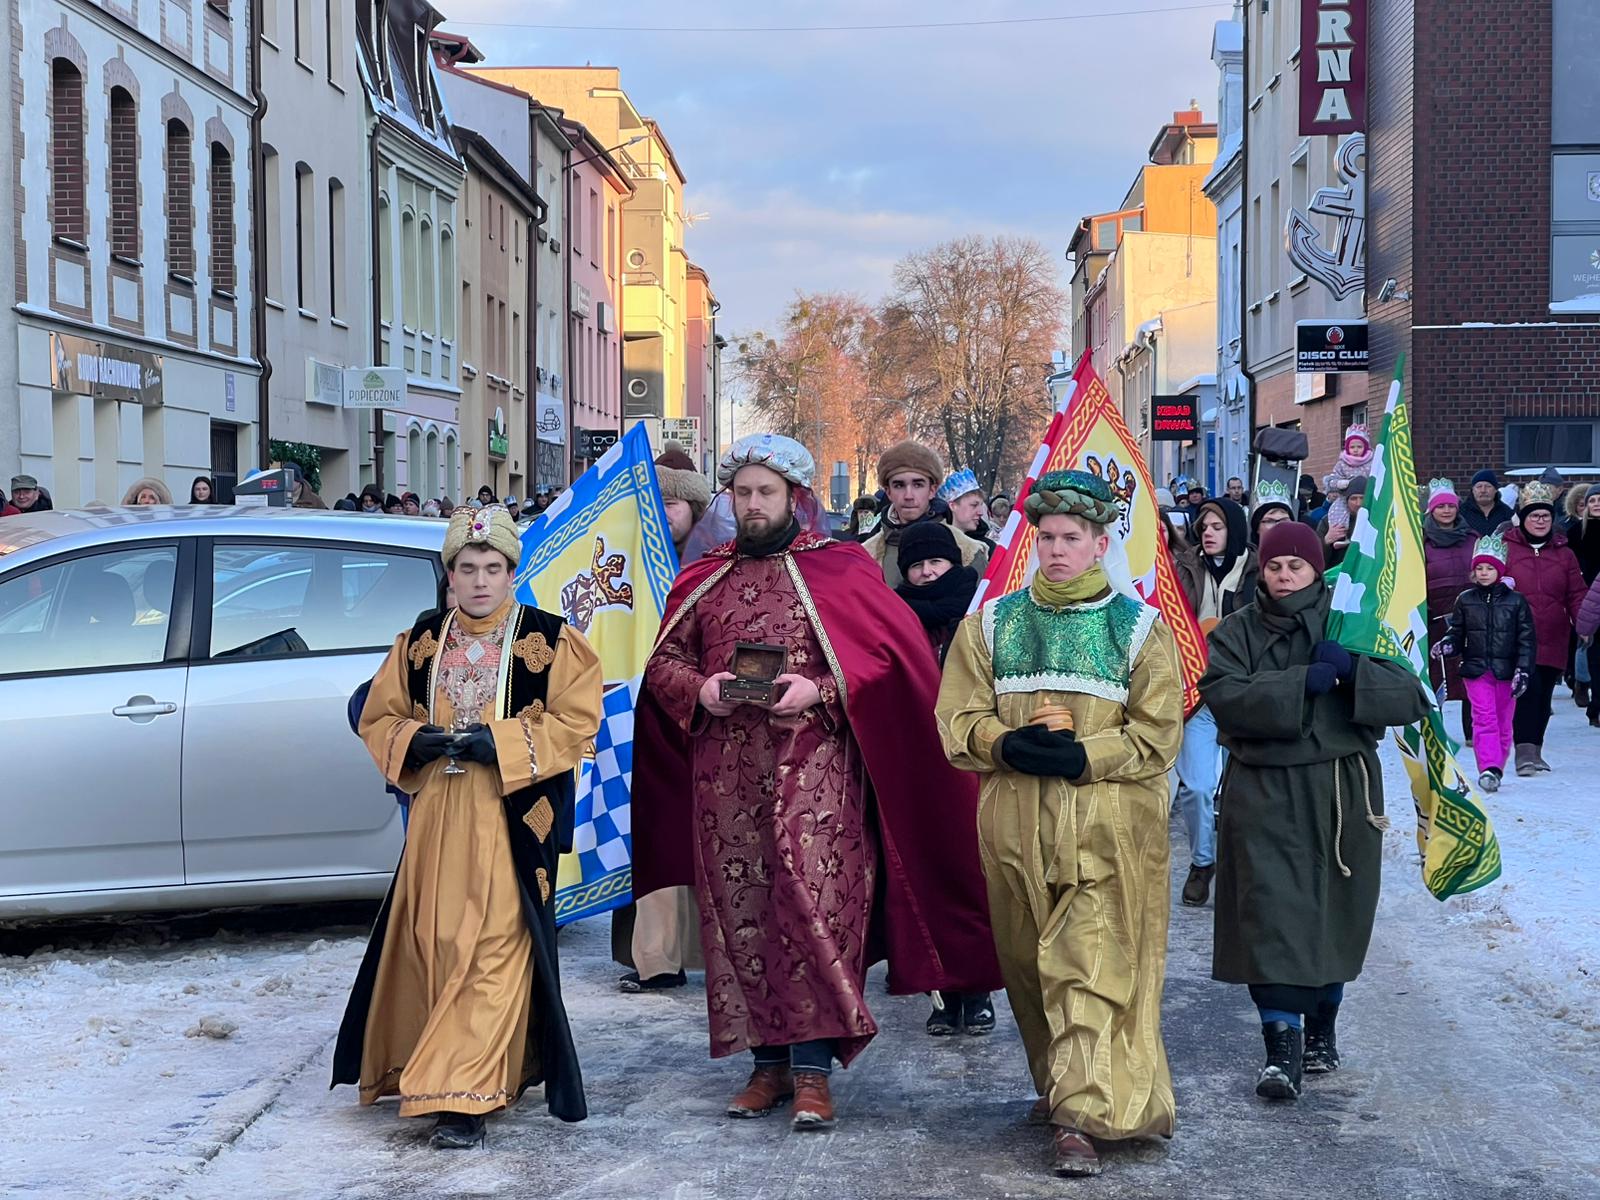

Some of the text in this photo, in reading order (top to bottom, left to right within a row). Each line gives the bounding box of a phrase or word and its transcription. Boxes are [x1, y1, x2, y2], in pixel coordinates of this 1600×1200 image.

[1314, 0, 1355, 122] RNA
[1299, 351, 1335, 359] DISCO
[349, 389, 401, 402] POPIECZONE
[1156, 405, 1192, 416] KEBAB
